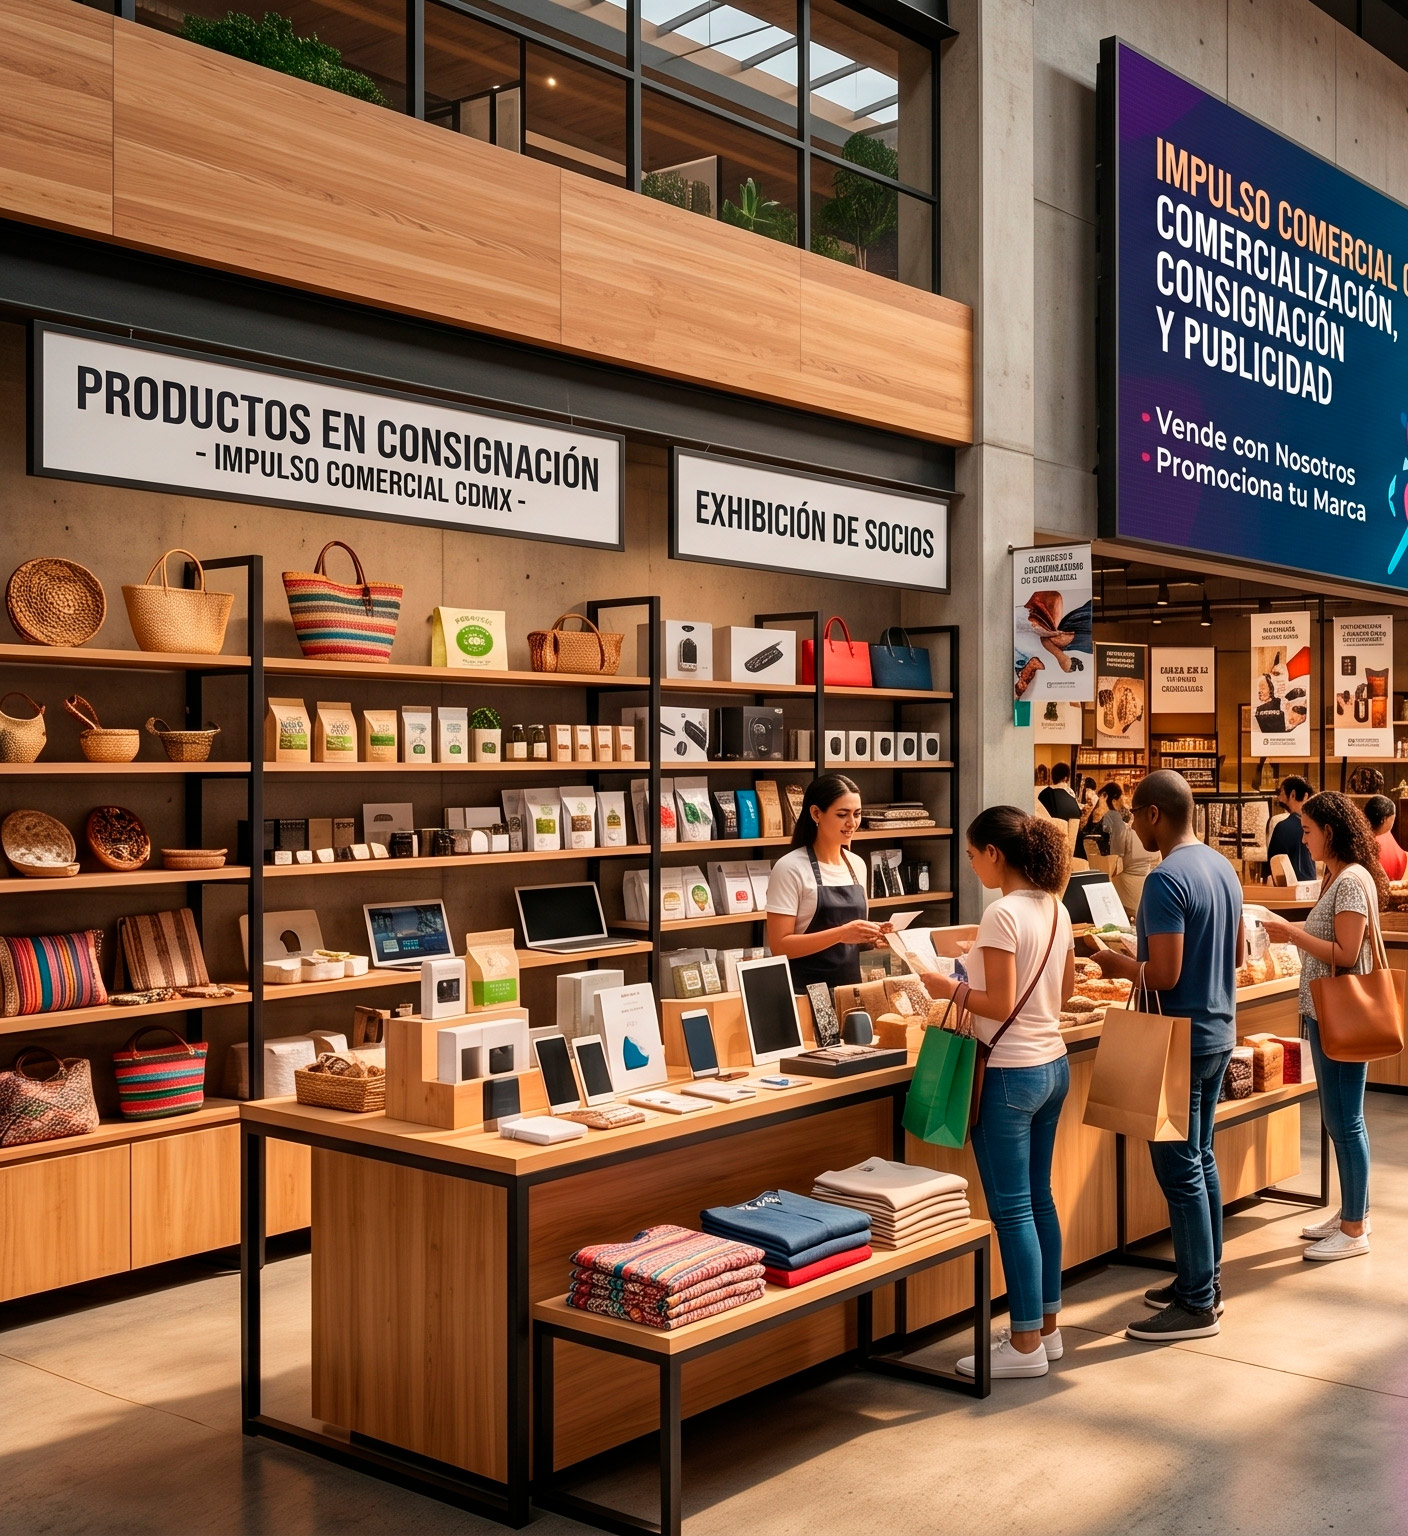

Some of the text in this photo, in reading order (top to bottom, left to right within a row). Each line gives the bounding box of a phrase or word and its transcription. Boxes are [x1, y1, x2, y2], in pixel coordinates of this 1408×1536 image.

[1156, 136, 1271, 231] IMPULSO
[1277, 200, 1398, 292] COMERCIAL
[1156, 194, 1398, 343] COMERCIALIZACIÓN,
[1156, 250, 1345, 363] CONSIGNACIÓN
[1155, 305, 1333, 406] Y PUBLICIDAD
[77, 364, 600, 493] PRODUCTOS EN CONSIGNACIÓN
[214, 442, 319, 484] IMPULSO
[326, 460, 450, 504] COMERCIAL
[455, 480, 513, 513] CDMX
[1155, 405, 1357, 486] Vende con Nosotros
[696, 489, 935, 559] EXHIBICIÓN DE SOCIOS
[1156, 446, 1367, 522] Promociona tu Marca
